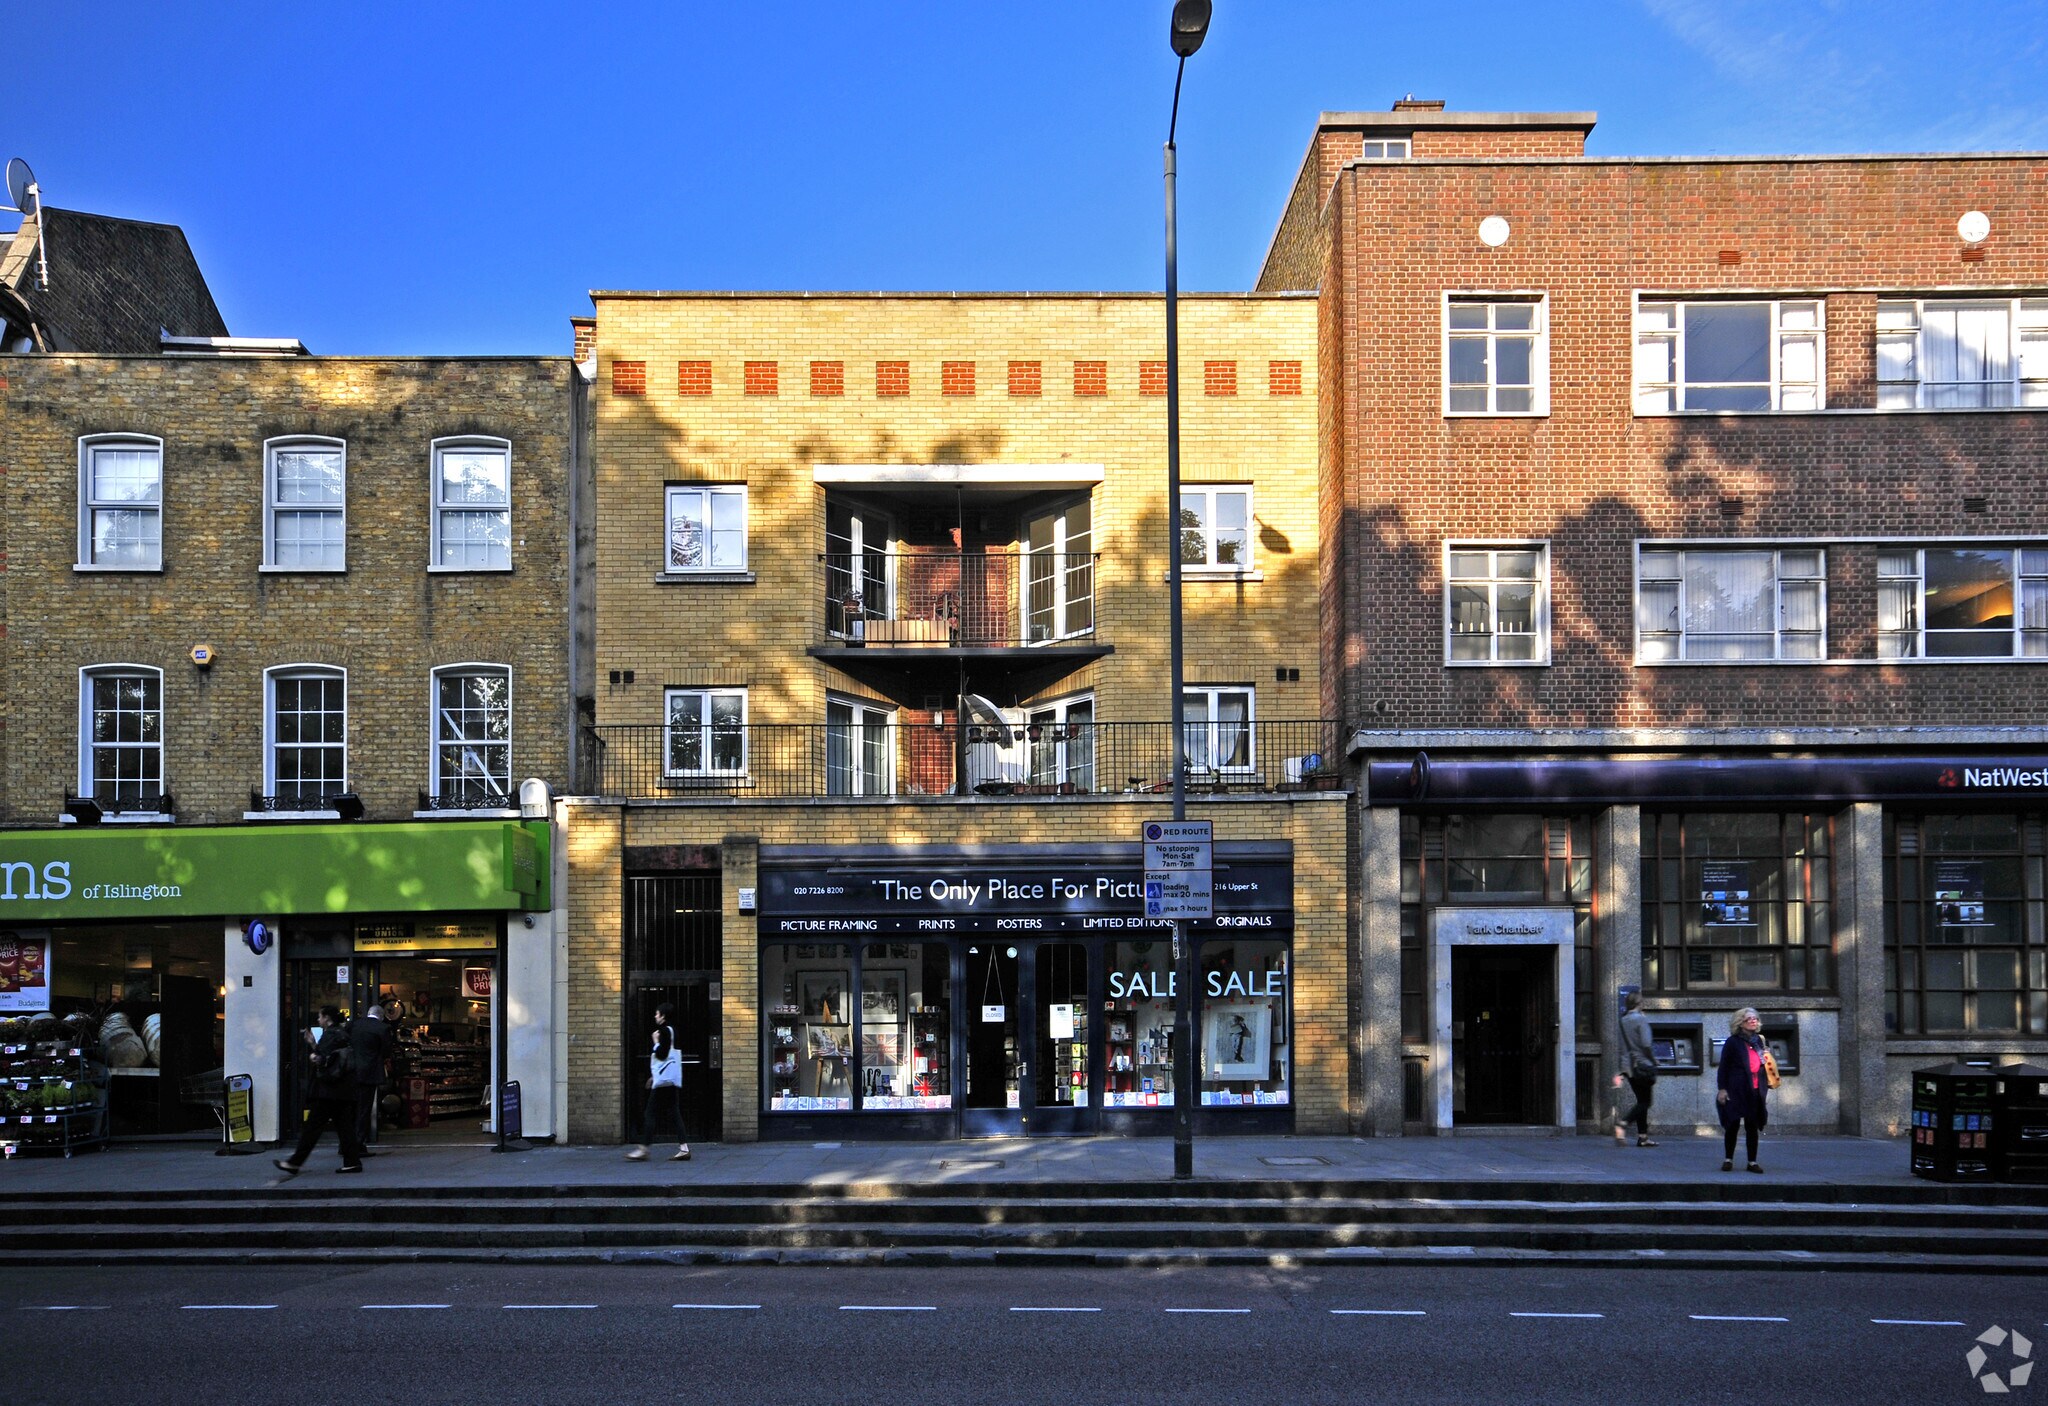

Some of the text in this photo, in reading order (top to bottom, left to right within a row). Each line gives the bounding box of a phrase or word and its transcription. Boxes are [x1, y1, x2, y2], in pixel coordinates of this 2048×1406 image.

[1964, 768, 2048, 787] NatWest
[1169, 845, 1200, 853] stopping
[0, 861, 182, 900] ns of Islington
[1145, 873, 1170, 881] Except
[793, 887, 807, 895] 020
[929, 879, 981, 906] Only
[988, 878, 1044, 899] Place
[1051, 879, 1088, 898] For
[1163, 883, 1190, 892] loading
[1228, 883, 1250, 893] Upper
[781, 916, 1272, 930] PICTURE FRAMING PRINTS POSTERS LIMITED EDITIONS ORIGINALS
[473, 973, 491, 982] HA
[473, 981, 491, 991] PRI
[1207, 970, 1282, 996] SALE
